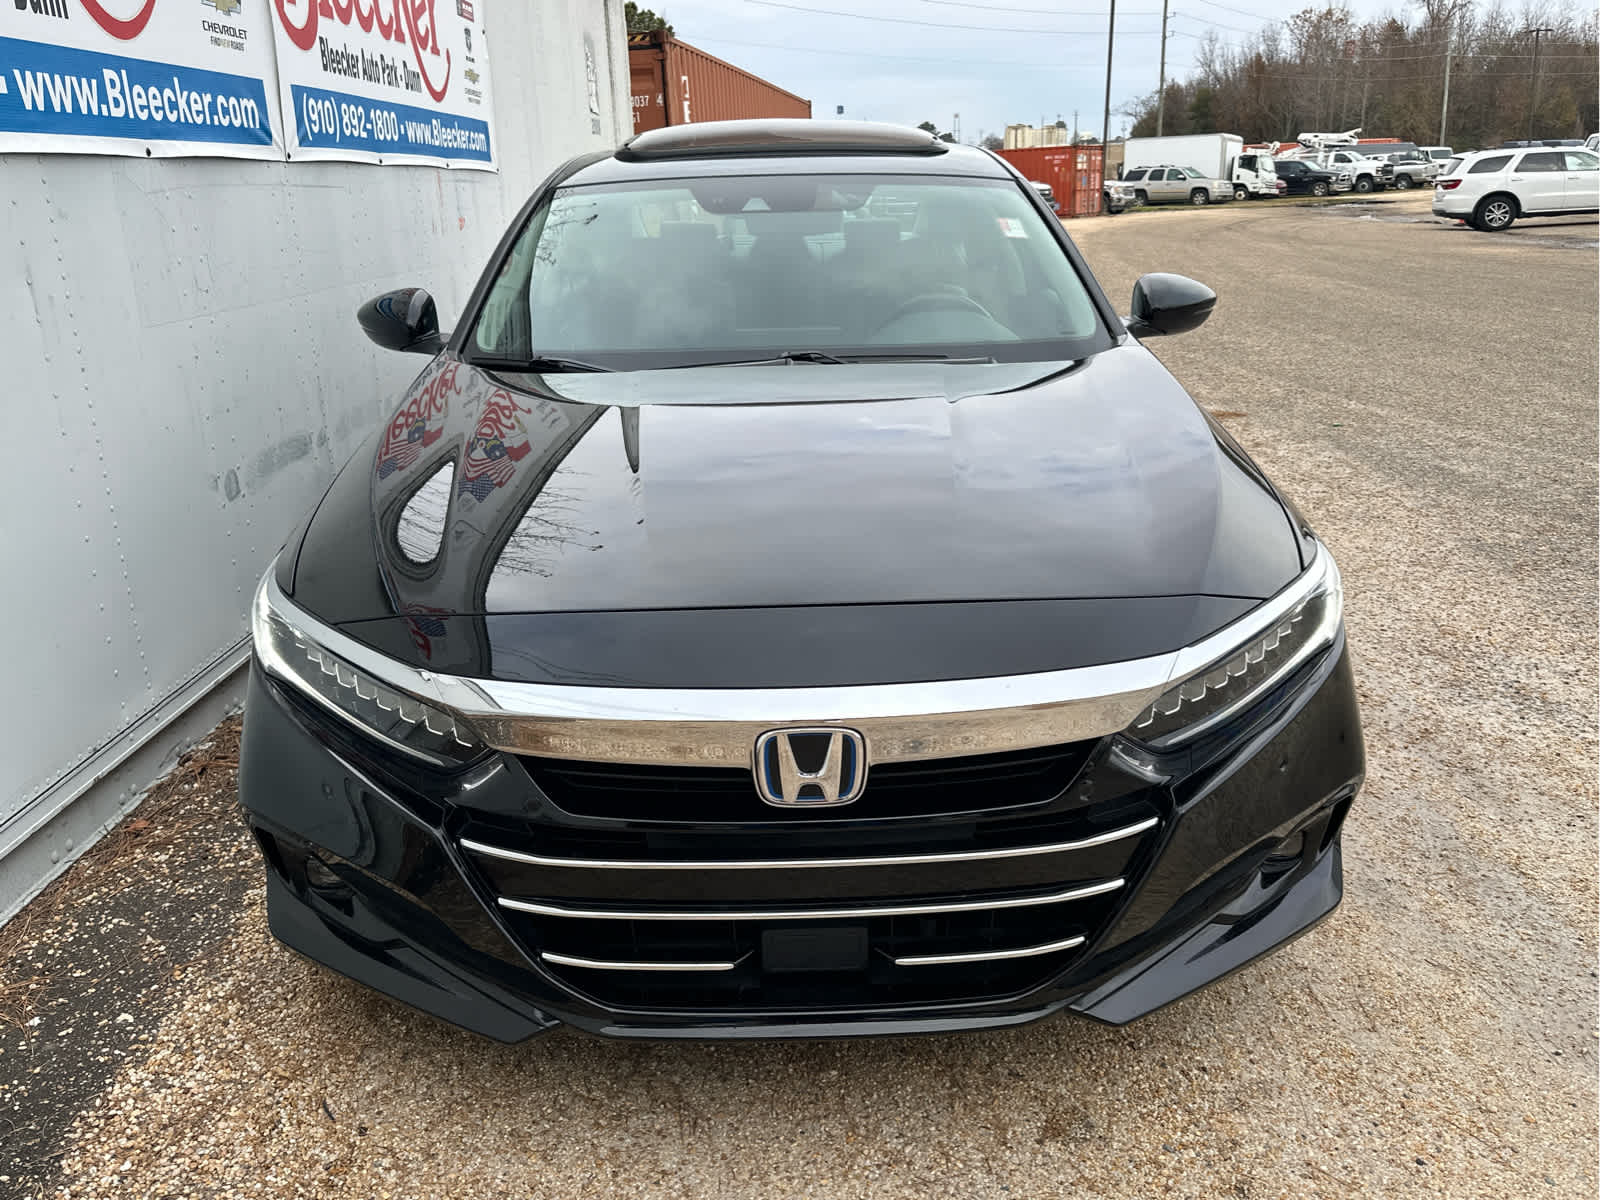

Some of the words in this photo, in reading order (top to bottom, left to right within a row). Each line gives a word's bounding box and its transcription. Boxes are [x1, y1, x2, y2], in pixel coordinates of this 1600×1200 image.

[202, 20, 248, 40] CHEVROLET
[319, 36, 360, 79] Bleecker
[361, 47, 380, 84] Auto
[380, 53, 400, 88] Park
[402, 60, 421, 93] Dunn
[12, 68, 260, 129] www.Bleecker.com
[303, 92, 340, 143] (910)
[341, 103, 399, 142] 892-1800
[405, 118, 487, 152] www.Bleecker.com
[656, 93, 664, 107] 4
